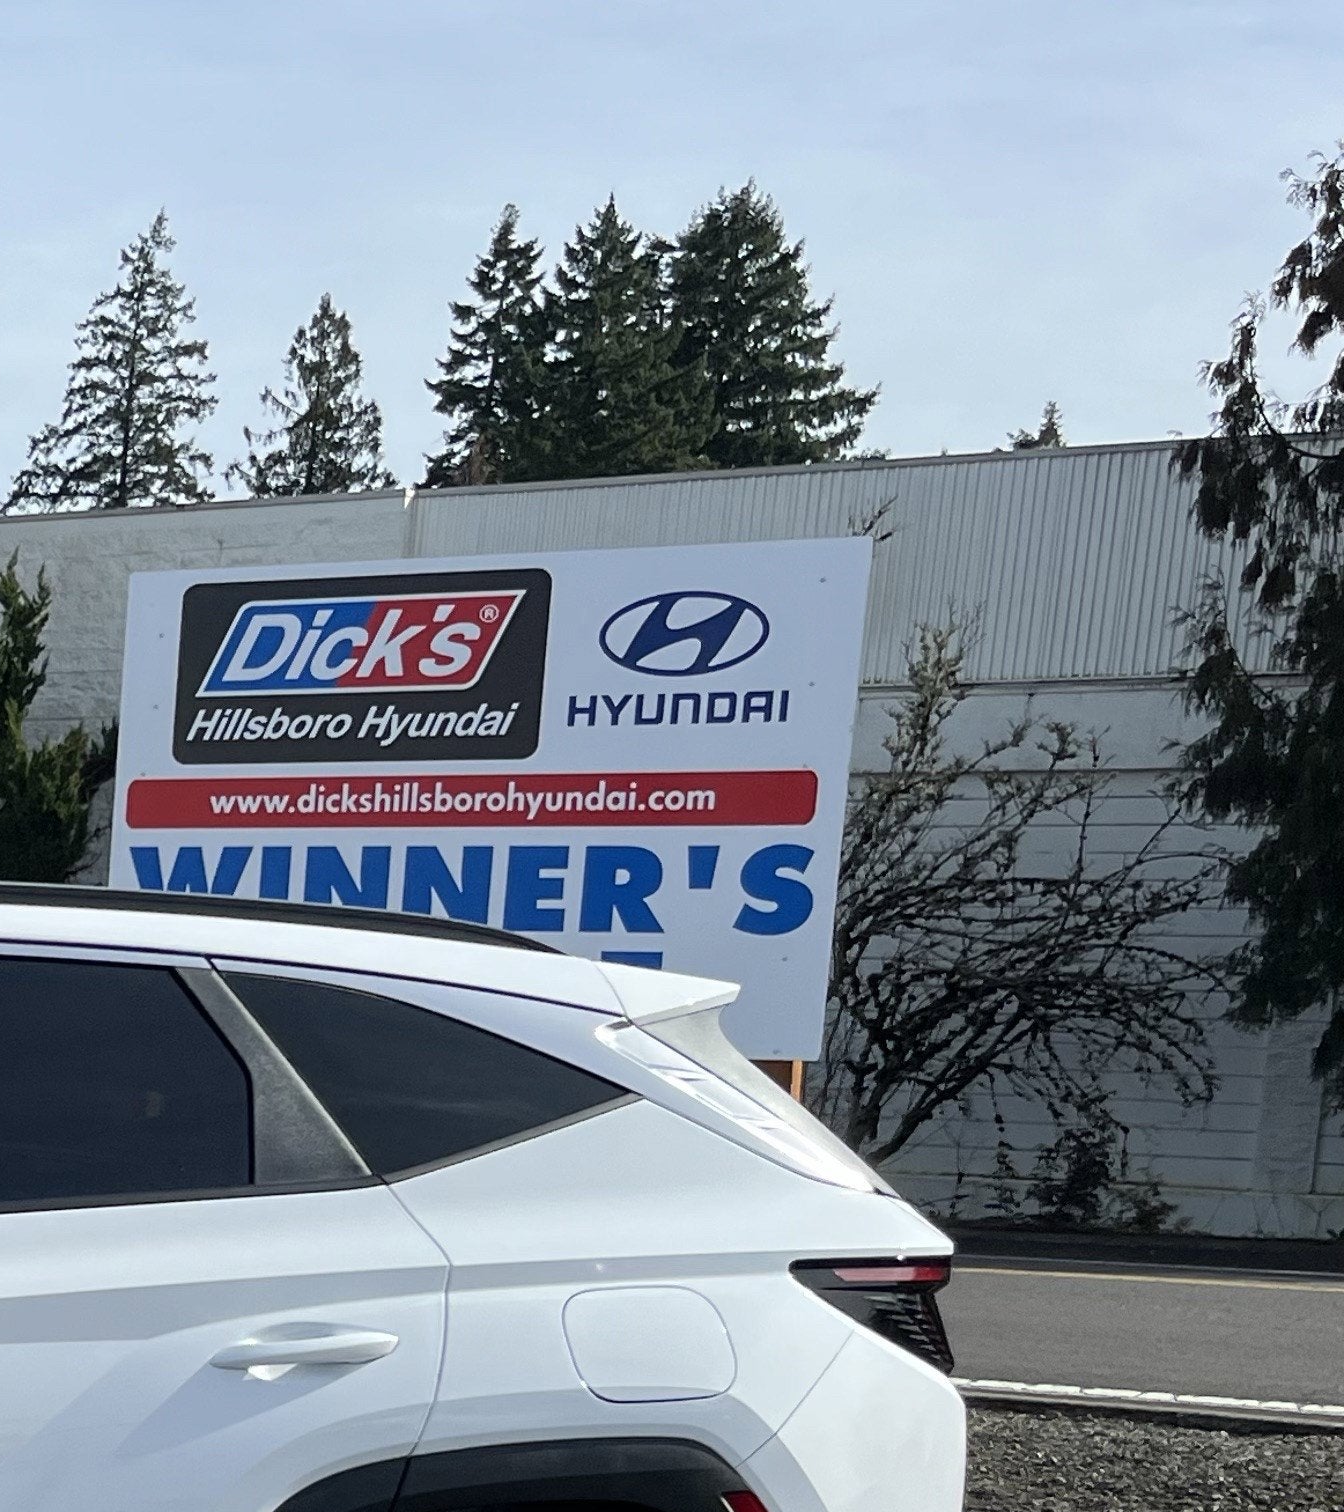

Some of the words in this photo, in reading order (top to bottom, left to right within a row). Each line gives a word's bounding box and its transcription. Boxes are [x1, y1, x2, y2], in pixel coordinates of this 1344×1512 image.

[186, 707, 352, 742] Hillsboro
[357, 703, 520, 746] Hyundai
[567, 690, 790, 727] HYUNDAI
[210, 779, 716, 820] www.dickshillsborohyundai.com
